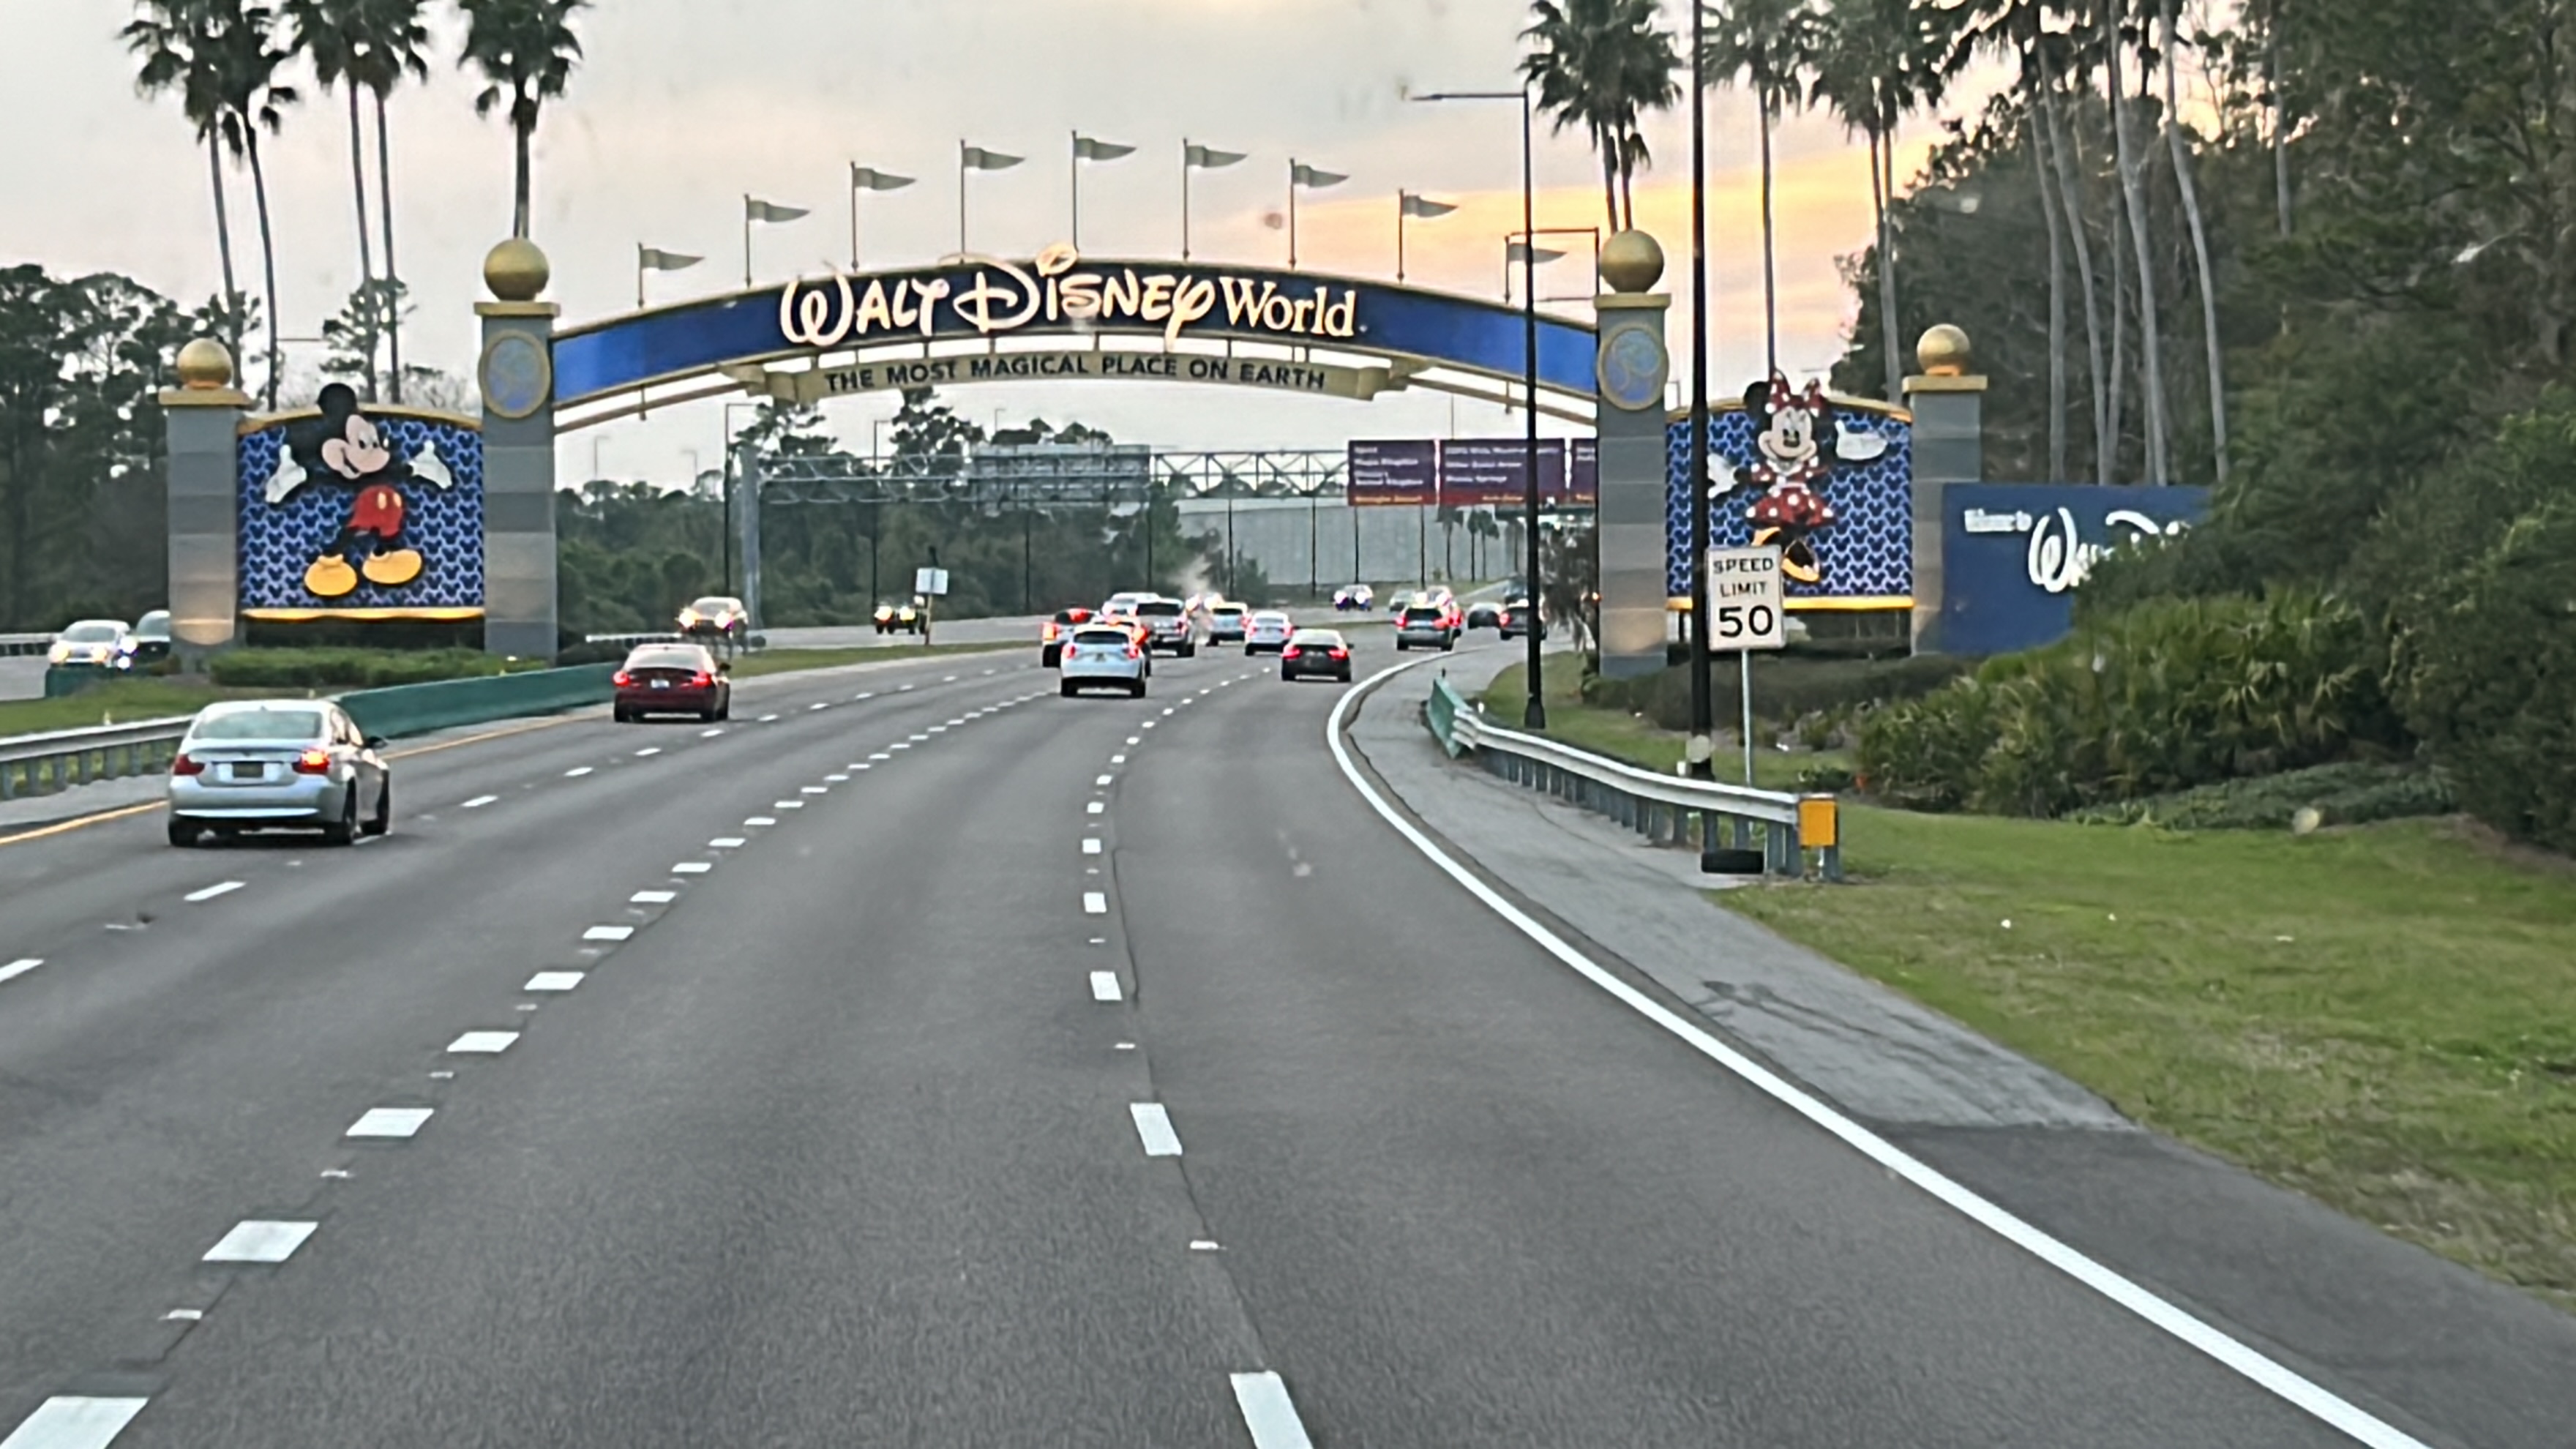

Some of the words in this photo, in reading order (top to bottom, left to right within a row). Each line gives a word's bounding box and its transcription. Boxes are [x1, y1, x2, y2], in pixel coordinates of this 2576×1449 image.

[780, 261, 949, 346] WALT
[1218, 276, 1355, 337] World
[825, 368, 875, 391] THE
[886, 361, 957, 384] MOST
[971, 355, 1088, 379] MAGICAL
[1103, 355, 1177, 376] PLACE
[1189, 359, 1227, 379] ON
[1240, 363, 1325, 389] EARTH
[1713, 558, 1774, 574] SPEED
[1720, 581, 1767, 598] LIMIT
[1719, 604, 1773, 637] 50
